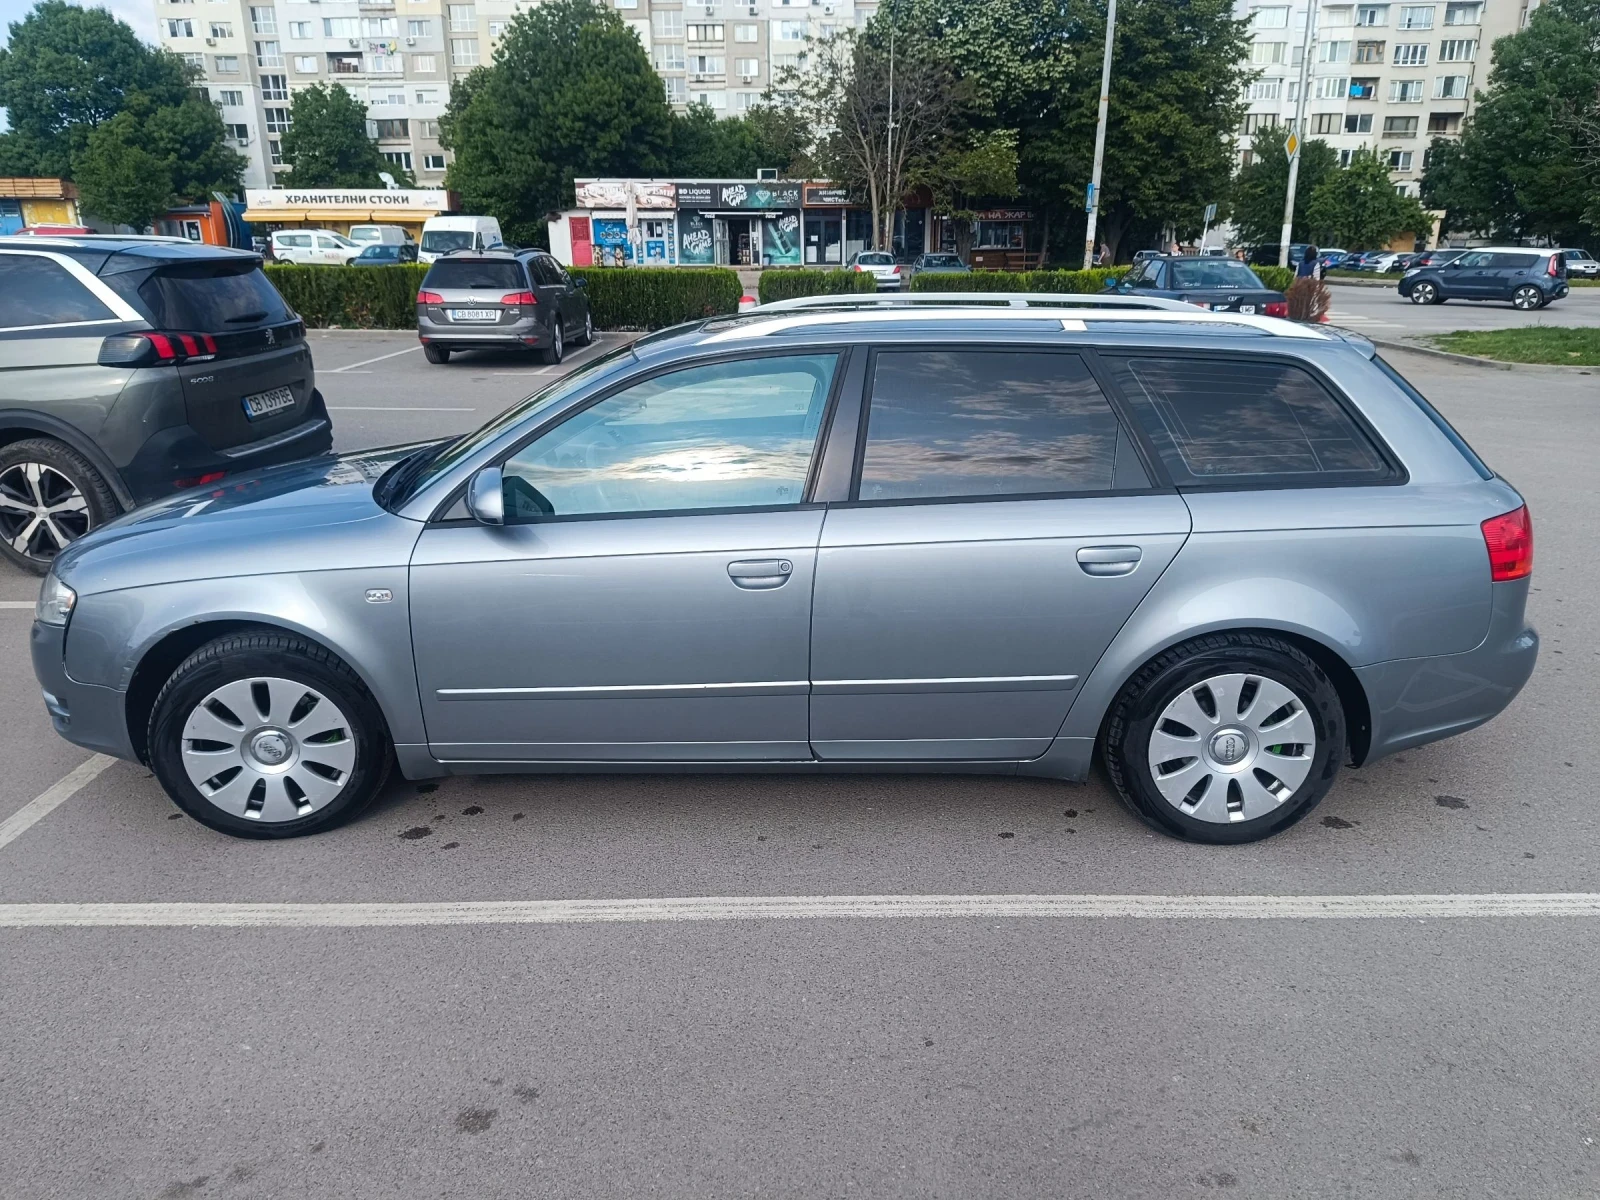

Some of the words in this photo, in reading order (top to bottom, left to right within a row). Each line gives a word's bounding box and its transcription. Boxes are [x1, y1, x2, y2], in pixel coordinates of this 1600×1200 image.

[285, 195, 367, 205] ХРАНИТЕЛНИ
[369, 195, 410, 205] СТОКИ
[721, 184, 746, 202] AHEAD
[728, 191, 748, 207] GAME
[1004, 211, 1026, 219] ЖАР
[682, 229, 710, 250] AHEAD
[690, 236, 713, 255] GAME
[456, 311, 469, 320] CB
[469, 311, 484, 320] 8081
[484, 311, 494, 320] XP
[190, 375, 214, 384] 5008
[248, 397, 263, 413] CB
[264, 391, 280, 409] 1399
[279, 387, 293, 404] BE
